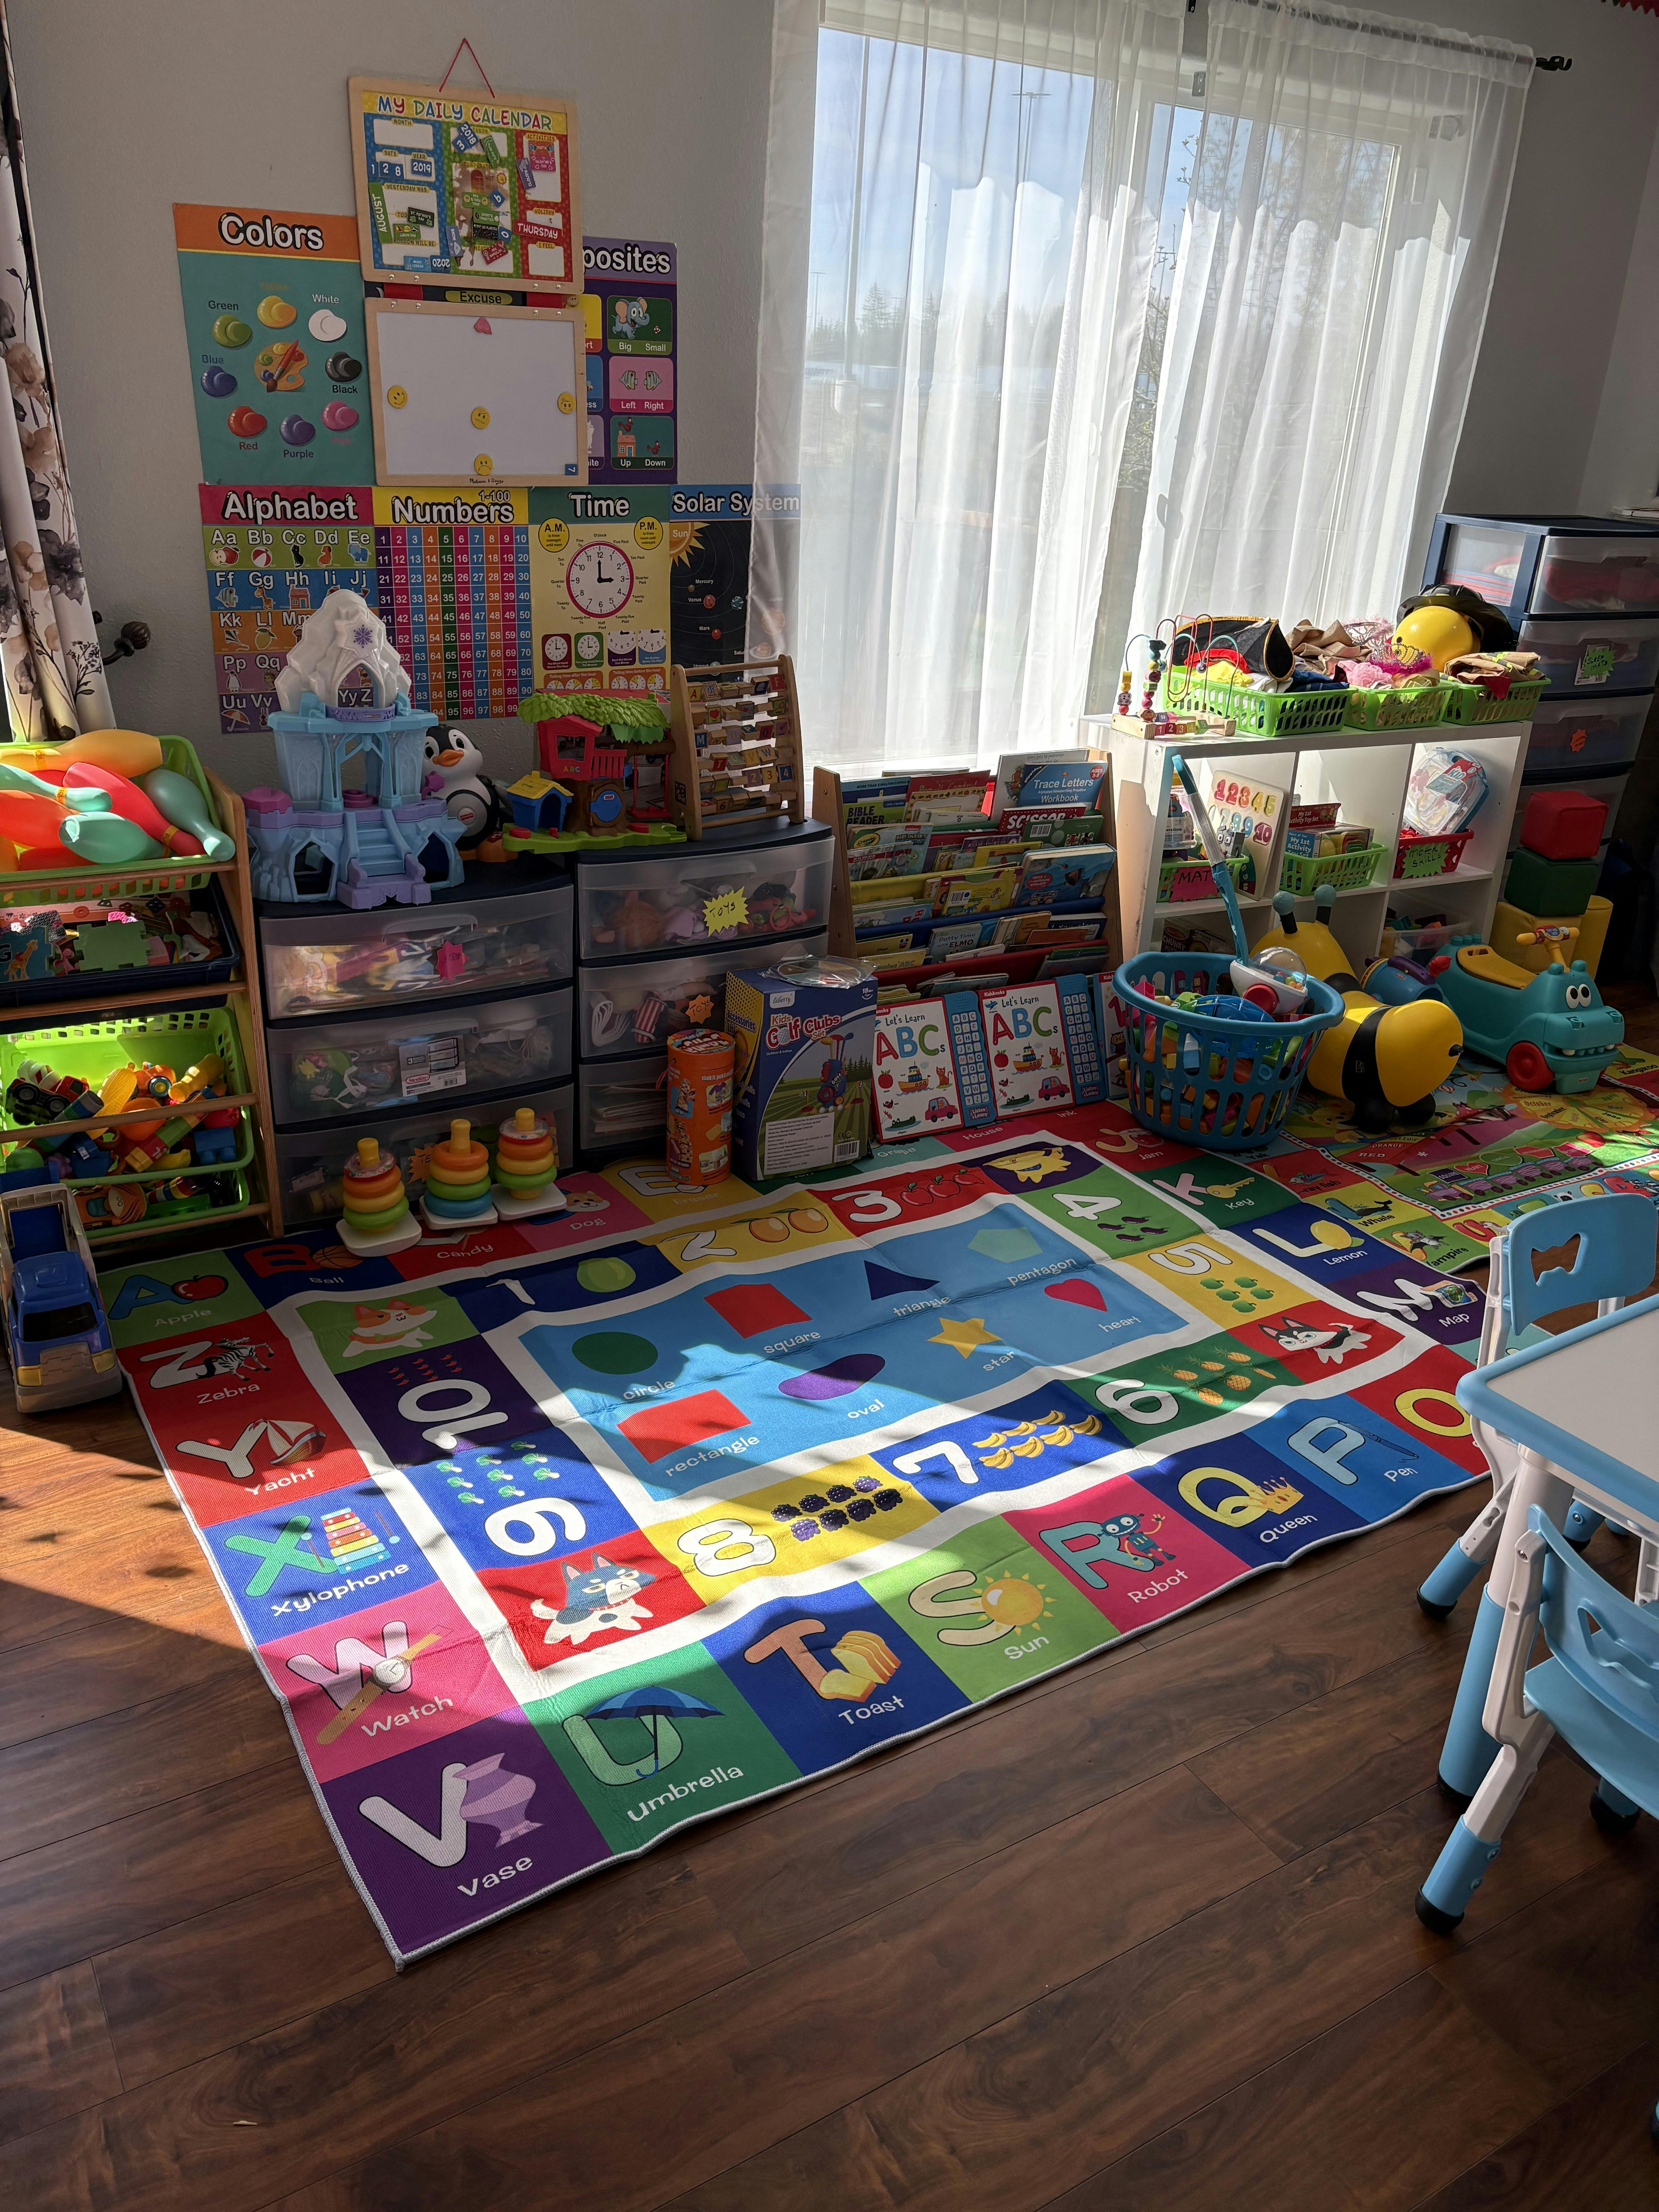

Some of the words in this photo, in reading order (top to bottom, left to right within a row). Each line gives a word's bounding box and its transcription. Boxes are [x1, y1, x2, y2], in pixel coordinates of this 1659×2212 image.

[378, 95, 405, 114] MY
[413, 100, 463, 120] DAILY
[471, 106, 551, 131] CALENDAR
[461, 124, 476, 145] 2018
[413, 162, 431, 173] 2019
[372, 194, 388, 233] AUGUST
[221, 214, 325, 251] Colors
[518, 223, 558, 239] THURSDAY
[433, 258, 450, 268] 2020
[208, 300, 239, 311] Green
[312, 294, 340, 304] White
[460, 292, 502, 304] Excuse
[619, 342, 632, 352] Big
[645, 343, 666, 352] Small
[201, 354, 224, 364] Blue
[332, 384, 358, 395] Black
[621, 401, 636, 409] Left
[644, 402, 664, 411] Right
[239, 441, 258, 450] Red
[283, 450, 314, 460] Purple
[620, 459, 631, 468] Up
[645, 459, 666, 467] Down
[479, 491, 511, 502] 1-100
[569, 494, 629, 517] Time
[673, 494, 725, 514] Solar
[731, 494, 800, 515] System
[224, 493, 358, 524] Alphabet
[392, 497, 514, 524] Numbers
[545, 524, 565, 532] A.M.
[640, 522, 657, 530] P.M.
[672, 529, 688, 538] Sun
[212, 530, 237, 544] Aa
[248, 530, 273, 544] Bb
[282, 530, 306, 544] Cc
[314, 530, 338, 544] Dd
[348, 530, 370, 544] Ee
[767, 770, 773, 780] 3
[784, 769, 789, 777] 4
[1034, 779, 1060, 789] Trace
[1061, 778, 1094, 788] Letters
[1041, 793, 1079, 804] Workbook
[1214, 779, 1226, 801] 1
[1226, 782, 1239, 805] 2
[1238, 786, 1250, 808] 3
[1252, 792, 1263, 812] 4
[1264, 794, 1277, 817] 5
[847, 815, 884, 824] READER
[848, 805, 875, 817] BIBLE
[858, 836, 876, 845] Crayola
[1253, 821, 1272, 845] 10
[1290, 836, 1299, 845] My
[1287, 843, 1311, 852] Activity
[709, 903, 736, 918] TOYS
[939, 934, 957, 943] Potty
[958, 932, 976, 940] Time
[949, 938, 974, 948] ELMO
[1162, 934, 1186, 951] CHUNKY
[689, 1000, 710, 1015] TOYS
[1001, 996, 1018, 1008] Let's
[1020, 996, 1039, 1005] Learn
[727, 1010, 756, 1032] Accessories
[771, 1015, 792, 1025] Kids
[885, 1014, 902, 1027] Let's
[905, 1014, 925, 1023] Learn
[993, 1006, 1058, 1046] ABCs
[766, 1019, 800, 1050] Golf
[803, 1015, 841, 1032] Clubs
[812, 1030, 826, 1040] Set
[876, 1024, 945, 1066] ABCs
[1619, 1064, 1659, 1076] Kangaroo
[1057, 1109, 1077, 1119] Ink
[962, 1126, 1004, 1141] House
[877, 1145, 917, 1159] Grape
[1138, 1150, 1164, 1162] Jam
[1151, 1172, 1210, 1206] K
[831, 1190, 903, 1223] 3
[1051, 1192, 1123, 1221] 4
[1225, 1196, 1254, 1211] Key
[569, 1217, 606, 1231] Dog
[1358, 1214, 1395, 1228] Whale
[437, 1243, 494, 1259] Candy
[661, 1230, 737, 1262] 2
[1252, 1227, 1327, 1259] L
[1148, 1242, 1234, 1276] 5
[1323, 1249, 1369, 1267] Lemon
[309, 1276, 344, 1285] Ball
[1007, 1257, 1077, 1286] pentagon
[893, 1294, 951, 1318] triangle
[1356, 1278, 1434, 1322] M
[155, 1309, 212, 1328] Apple
[1098, 1316, 1142, 1333] heart
[1438, 1311, 1470, 1329] Map
[763, 1329, 821, 1355] square
[139, 1341, 228, 1389] Z
[982, 1350, 1015, 1372] star
[197, 1383, 260, 1405] Zebra
[623, 1378, 675, 1401] circle
[847, 1399, 885, 1420] oval
[1094, 1377, 1180, 1425] 6
[397, 1378, 508, 1450] 10
[175, 1420, 268, 1479] Y
[665, 1434, 760, 1478] rectangle
[1288, 1415, 1366, 1486] P
[892, 1440, 980, 1485] 7
[244, 1467, 316, 1497] Yacht
[1384, 1466, 1419, 1483] Pen
[1178, 1467, 1265, 1528] Q
[1259, 1512, 1318, 1544] Queen
[226, 1513, 338, 1597] X
[677, 1518, 776, 1577] 8
[1038, 1521, 1155, 1590] R
[270, 1563, 410, 1617] Xylophone
[1127, 1567, 1190, 1604] Robot
[908, 1570, 1015, 1647] S
[1003, 1634, 1051, 1661] Sun
[286, 1620, 413, 1711] W
[743, 1619, 836, 1700] T
[360, 1694, 454, 1737] Watch
[838, 1694, 905, 1726] Toast
[626, 1764, 744, 1823] Umbrella
[358, 1762, 470, 1868] V
[457, 1856, 534, 1897] Vase
